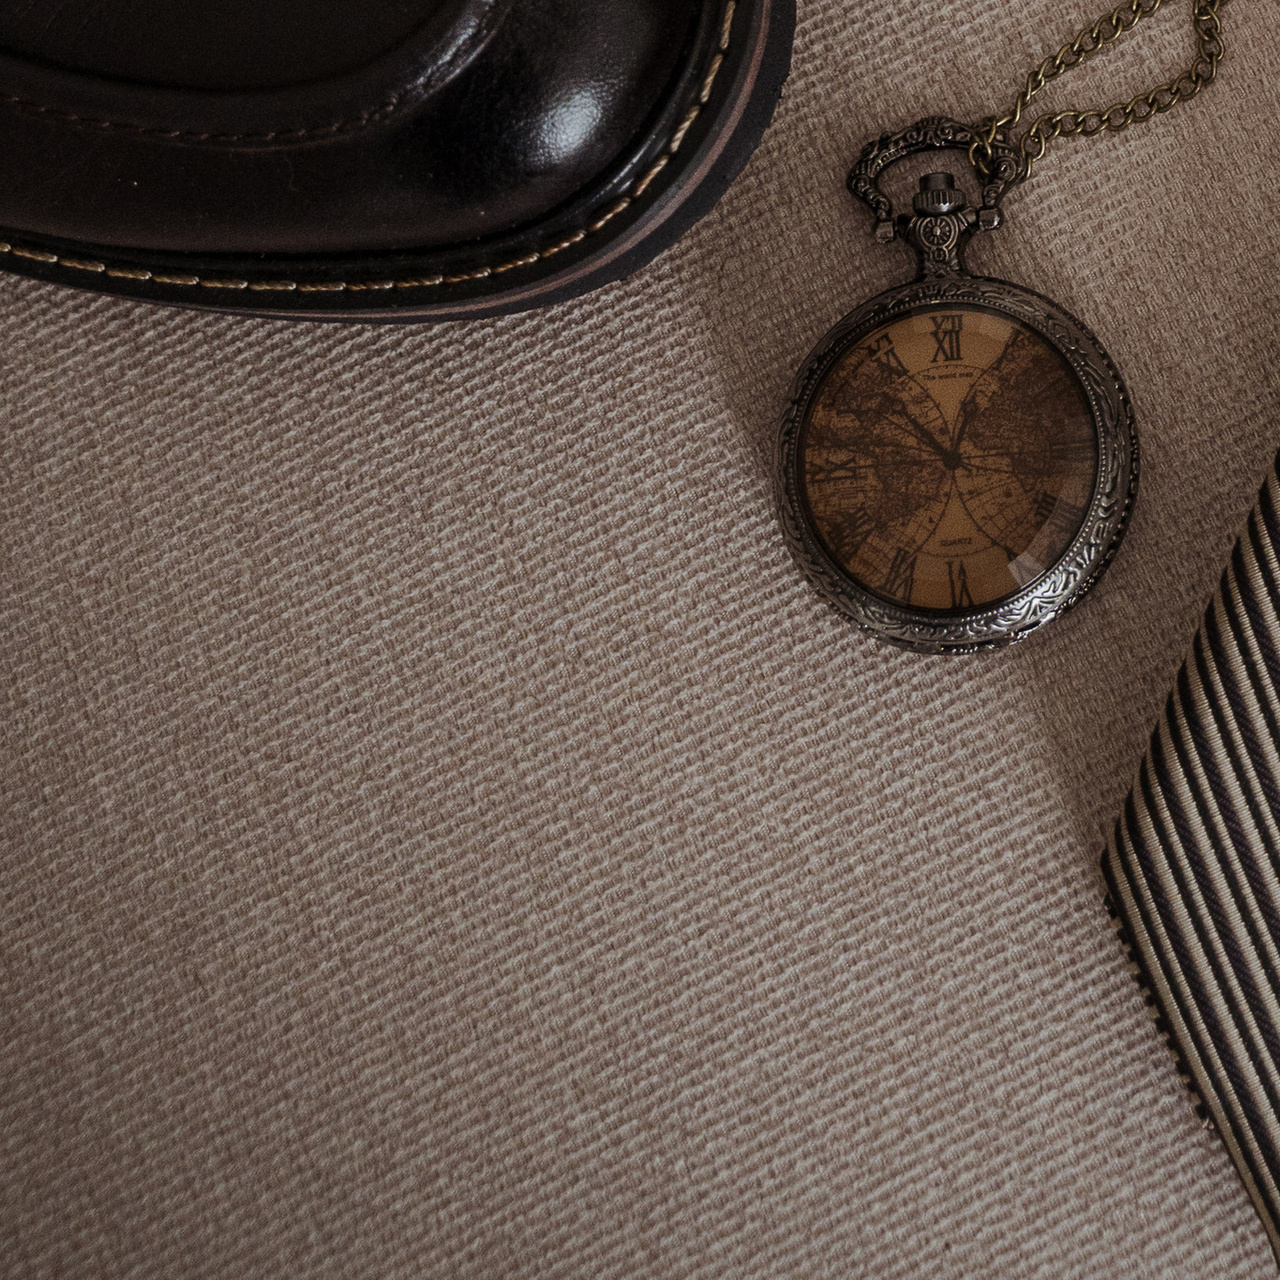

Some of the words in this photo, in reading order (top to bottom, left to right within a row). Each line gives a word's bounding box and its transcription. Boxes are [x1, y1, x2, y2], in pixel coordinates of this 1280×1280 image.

[929, 326, 963, 363] XII
[940, 537, 972, 546] QUARTZ
[946, 560, 974, 607] VI
